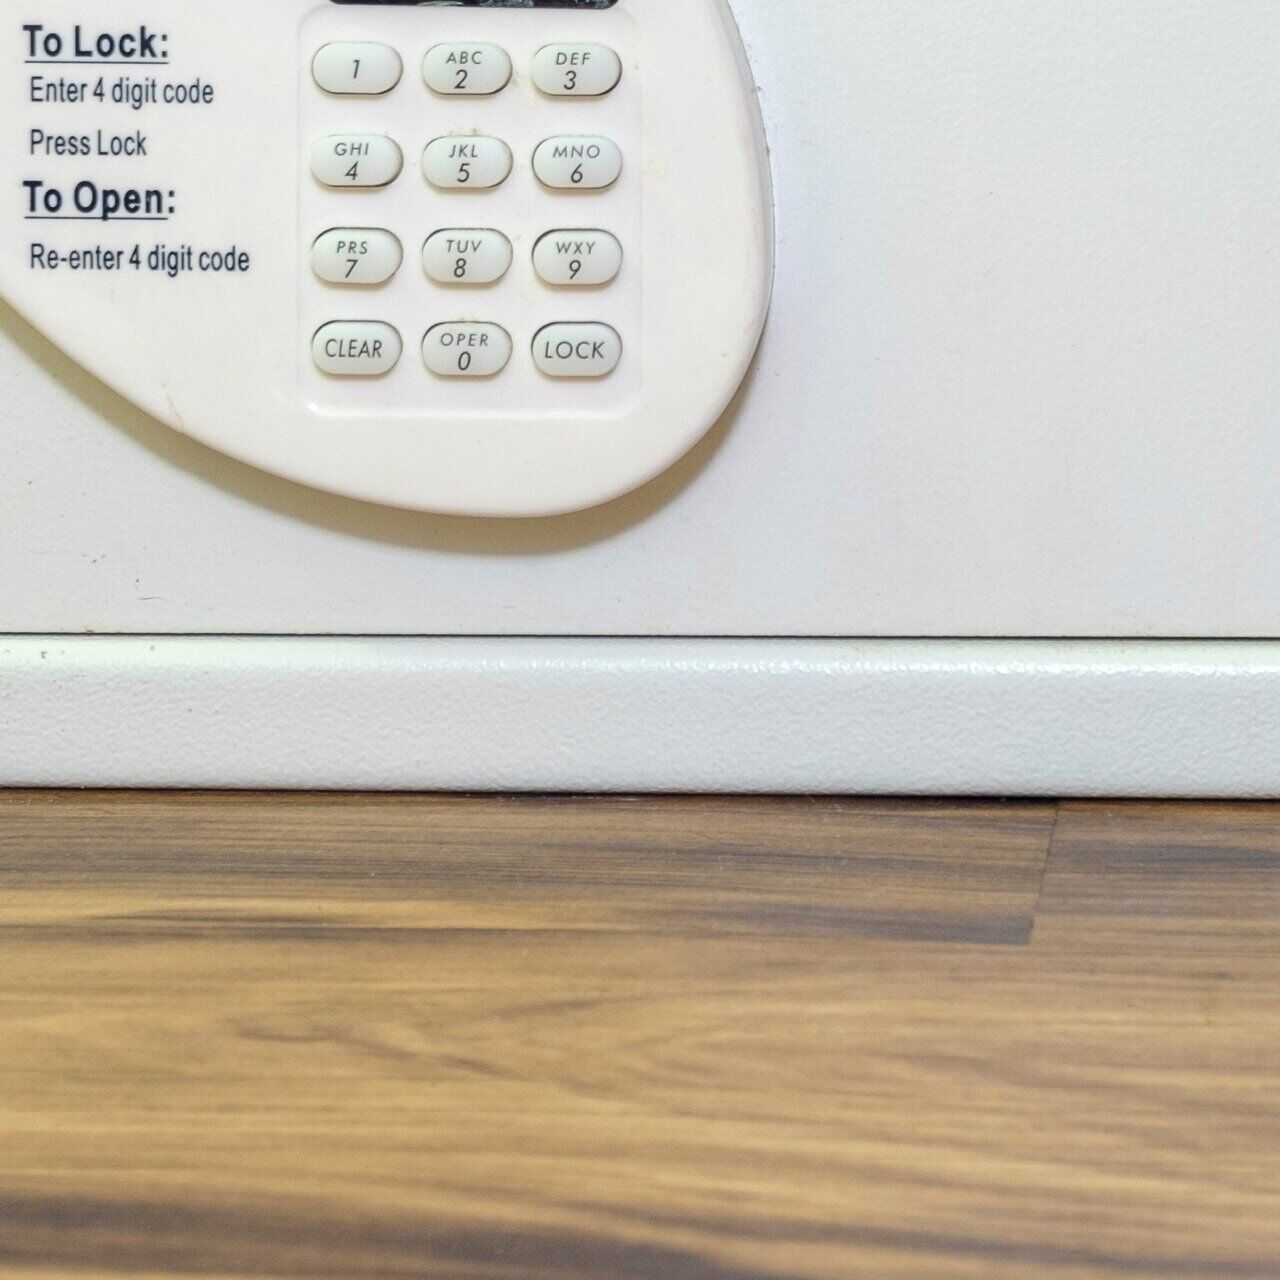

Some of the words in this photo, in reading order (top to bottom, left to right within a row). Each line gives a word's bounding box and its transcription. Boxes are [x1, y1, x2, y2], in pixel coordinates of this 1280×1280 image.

[23, 25, 62, 57] To
[75, 25, 167, 58] Lock:
[446, 51, 481, 64] ABC
[556, 52, 590, 65] DEF
[351, 59, 360, 79] 1
[455, 70, 467, 89] 2
[564, 71, 576, 90] 3
[31, 76, 87, 102] Enter
[93, 77, 104, 102] 4
[112, 78, 156, 110] digit
[164, 79, 213, 103] code
[31, 129, 90, 155] Press
[98, 130, 146, 156] Lock
[335, 143, 368, 156] GHI
[449, 145, 477, 158] JKL
[553, 145, 600, 158] MNO
[345, 162, 358, 180] 4
[458, 163, 469, 183] 5
[571, 164, 583, 183] 6
[23, 181, 62, 213] To
[73, 180, 176, 220] Open:
[337, 241, 367, 254] PRS
[447, 240, 481, 253] TUV
[557, 242, 595, 254] WXY
[31, 243, 124, 270] Re-enter
[129, 245, 141, 269] 4
[148, 245, 192, 277] digit
[199, 246, 249, 271] code
[345, 259, 358, 278] 7
[454, 258, 466, 278] 8
[569, 260, 581, 279] 9
[326, 339, 382, 357] CLEAR
[441, 333, 488, 346] OPER
[545, 342, 603, 359] LOCK
[458, 351, 471, 371] 0
